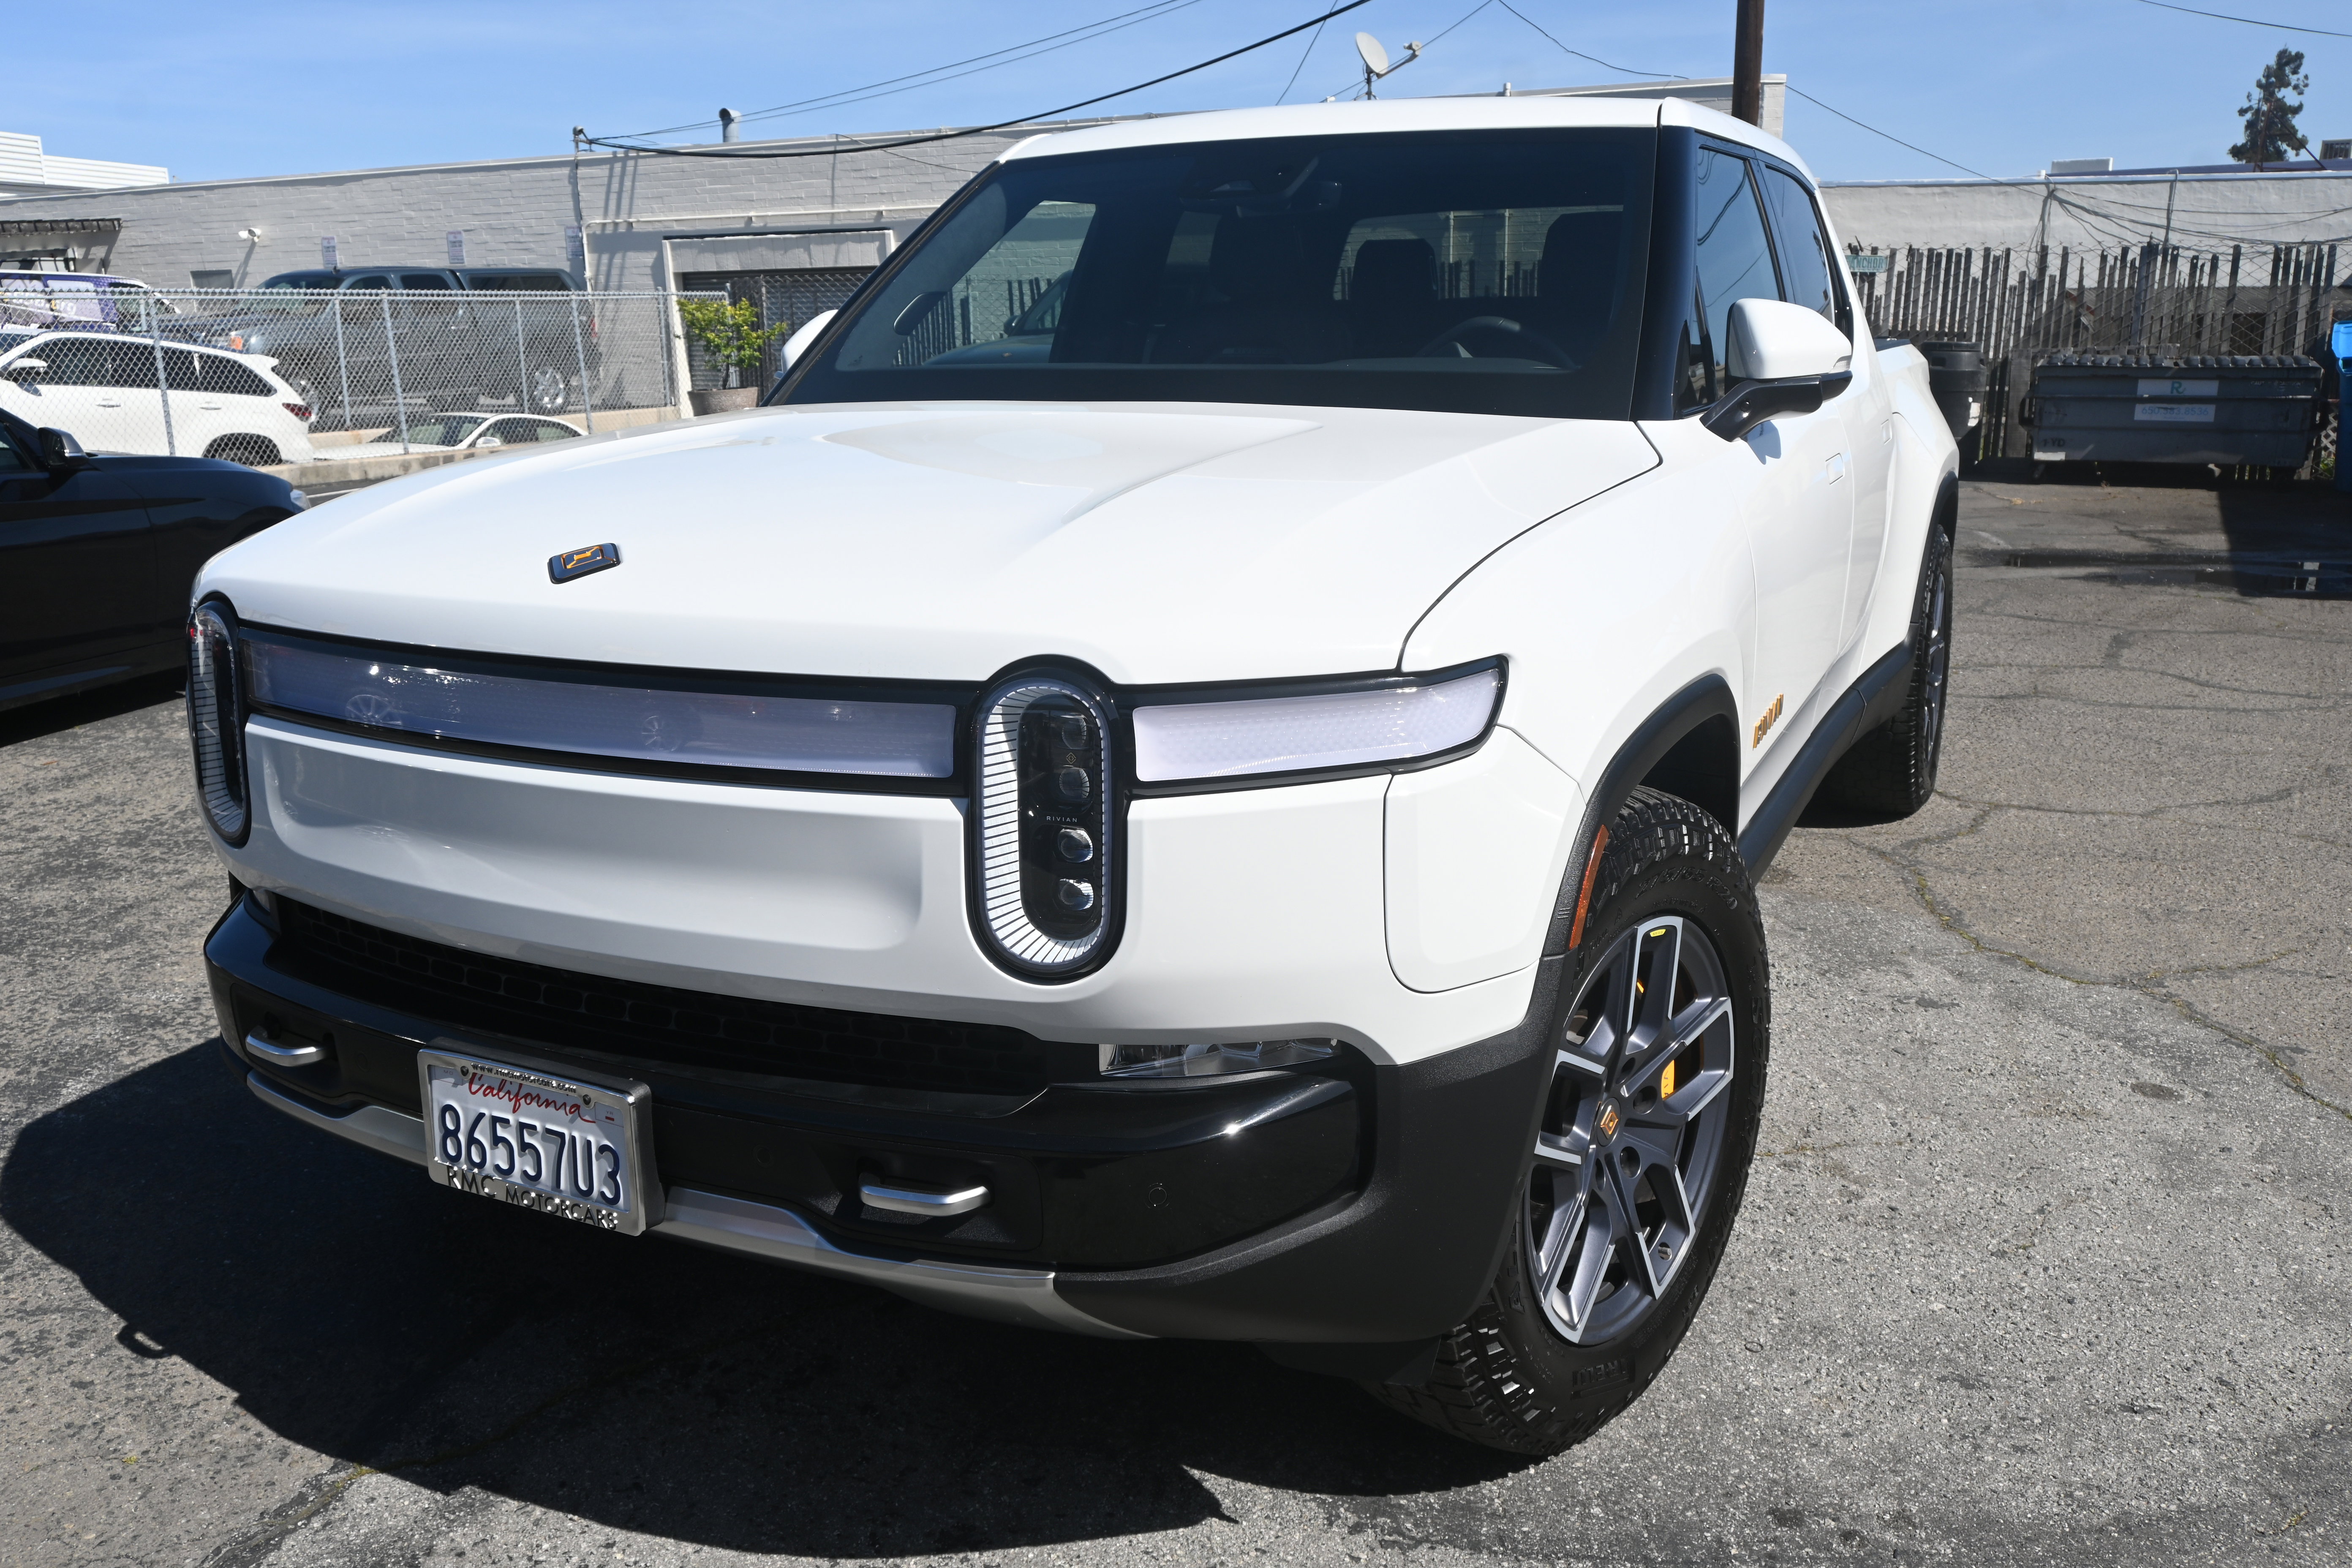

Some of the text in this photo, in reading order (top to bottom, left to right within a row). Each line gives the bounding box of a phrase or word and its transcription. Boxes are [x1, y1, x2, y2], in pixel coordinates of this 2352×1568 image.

[1635, 865, 1707, 900] 275/65
[1706, 874, 1738, 909] R20
[468, 1073, 596, 1123] California
[471, 1062, 577, 1093] www.rmcmotorcars.com
[441, 1103, 621, 1206] 86557U3
[1707, 997, 1763, 1267] SCORPION
[447, 1165, 618, 1230] RMC MOTORCARS
